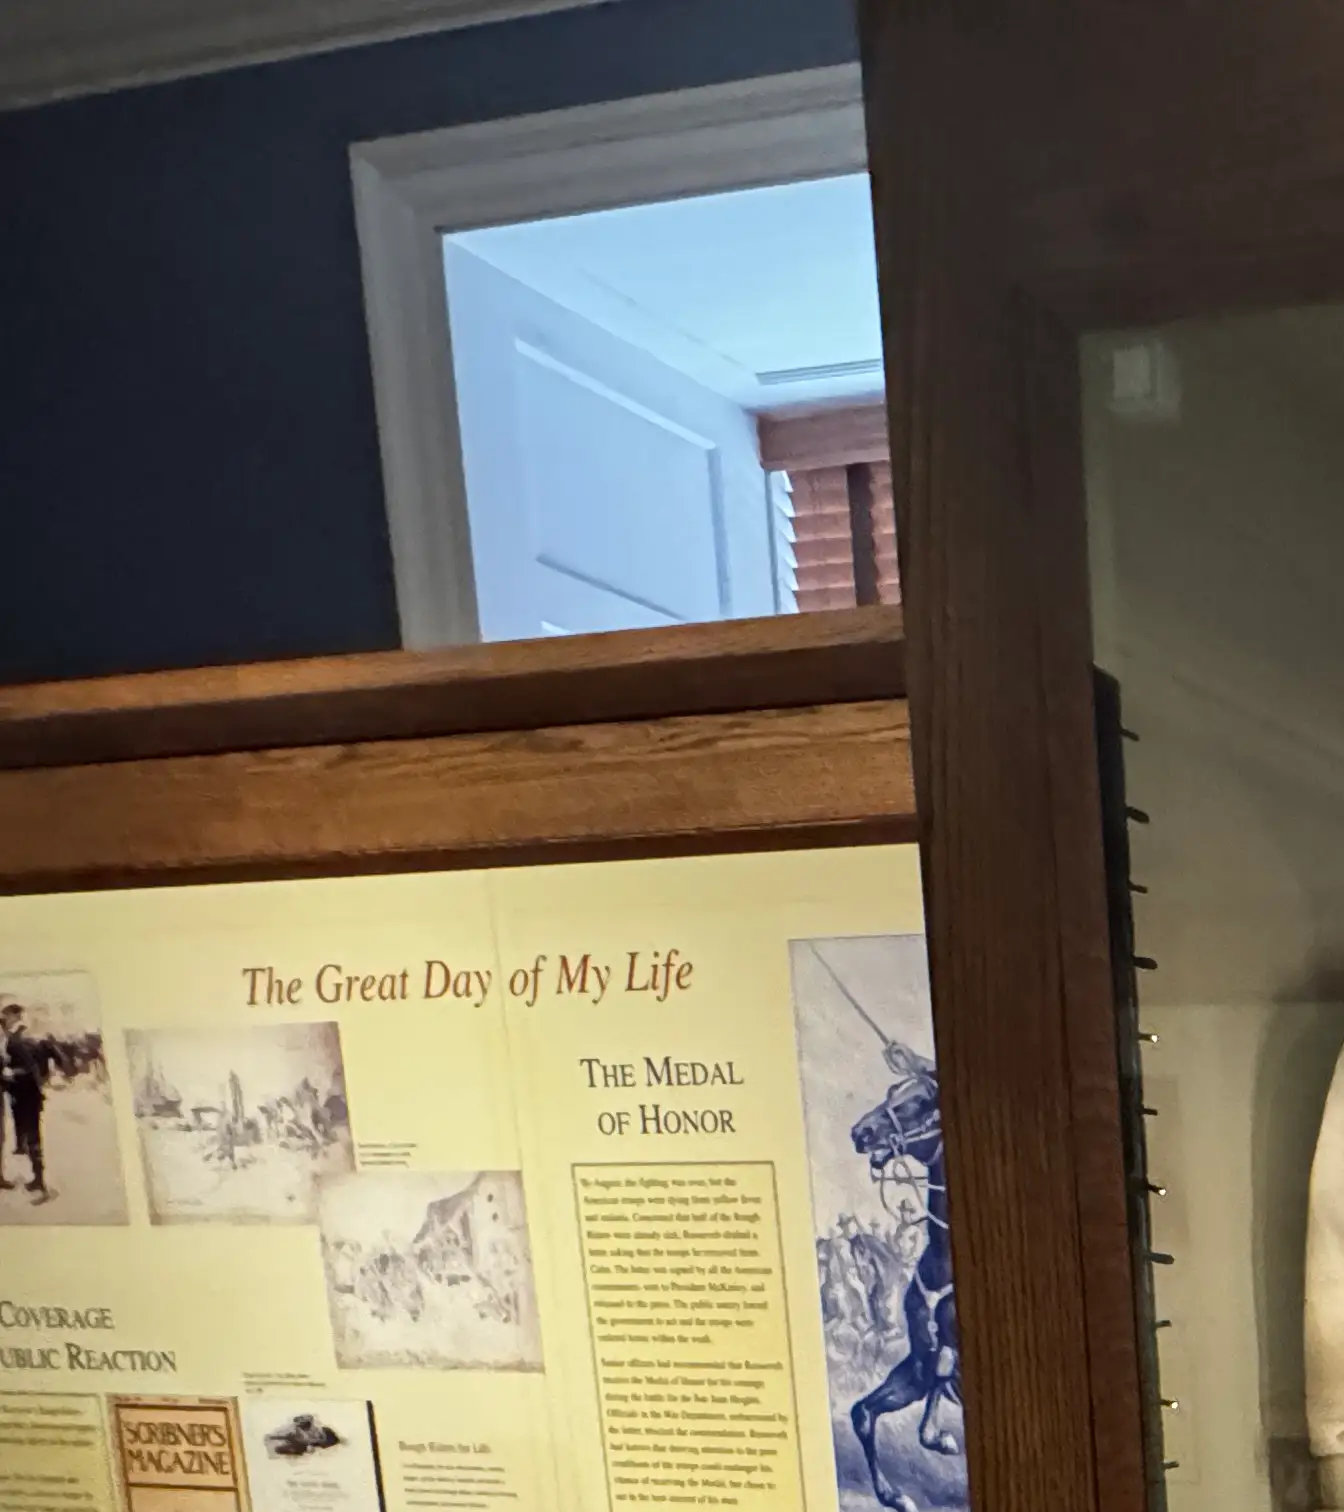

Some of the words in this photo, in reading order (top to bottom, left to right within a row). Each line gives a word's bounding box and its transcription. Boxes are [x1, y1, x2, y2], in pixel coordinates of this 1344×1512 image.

[242, 966, 303, 1007] The
[315, 964, 409, 1004] Great
[423, 960, 492, 1008] Day
[509, 955, 547, 1007] of
[556, 953, 611, 1005] My
[625, 948, 694, 1003] Life
[580, 1057, 636, 1089] THE
[646, 1056, 744, 1087] MEDAL
[598, 1111, 630, 1136] OF
[639, 1104, 736, 1134] HONOR
[0, 1300, 115, 1329] COVERAGE
[65, 1341, 178, 1373] REACTION
[126, 1450, 230, 1475] MAGAZINE
